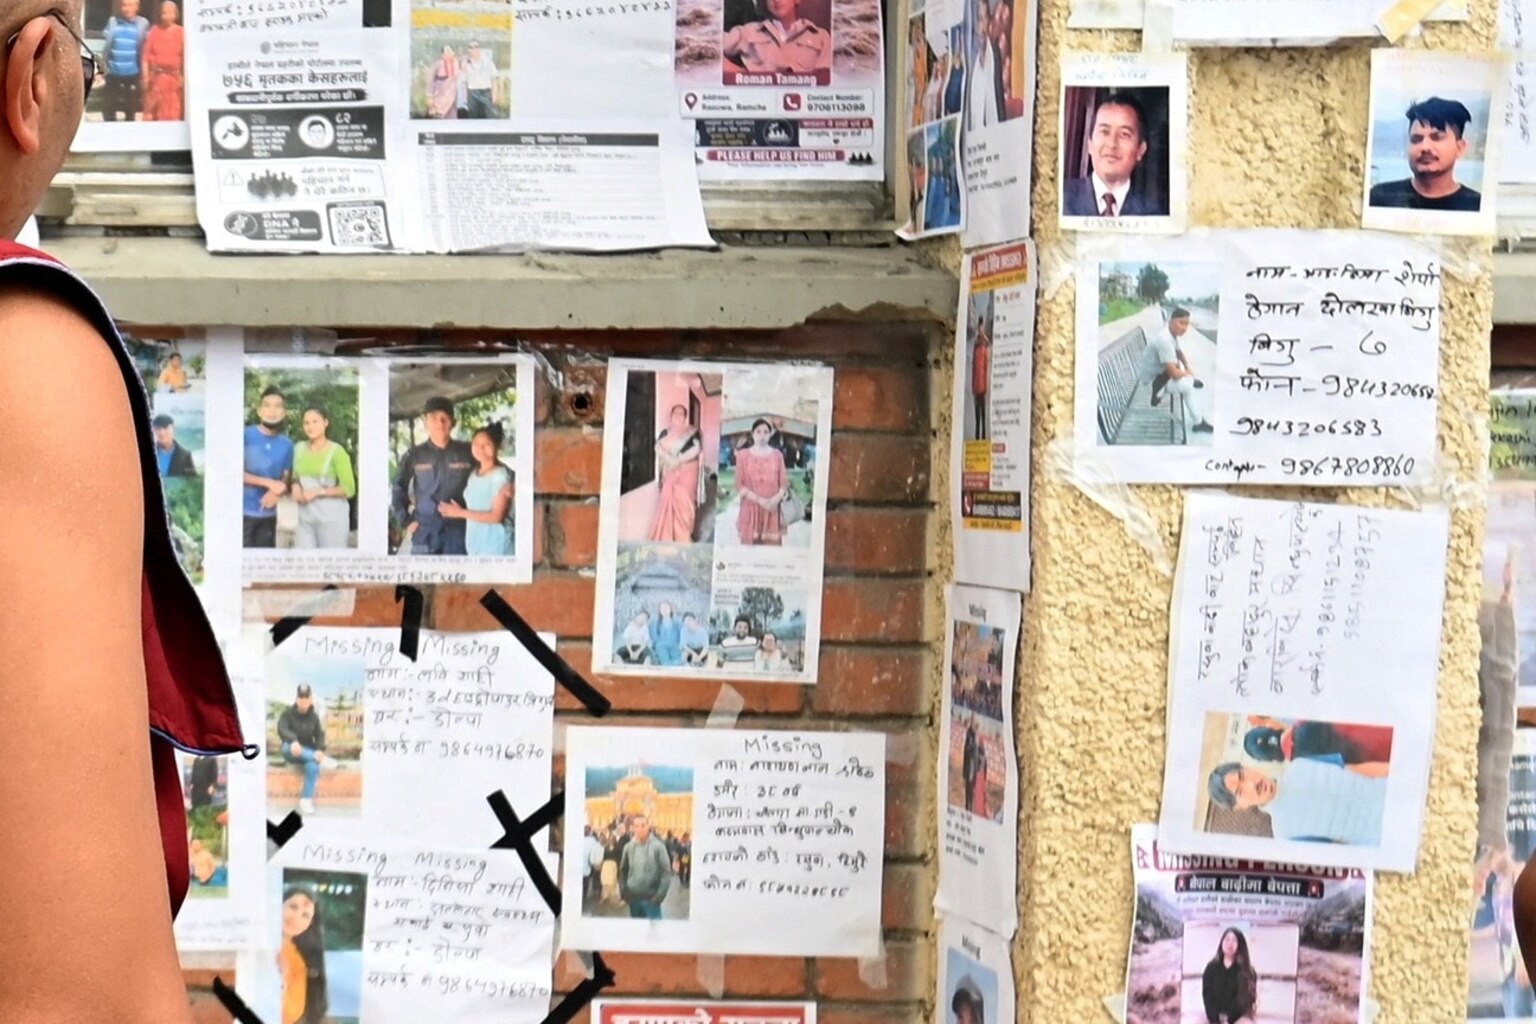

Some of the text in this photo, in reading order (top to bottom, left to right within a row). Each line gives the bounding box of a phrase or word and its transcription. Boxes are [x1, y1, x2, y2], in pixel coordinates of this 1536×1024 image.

[736, 74, 817, 86] Roman Tamang
[717, 150, 837, 161] PLEASE HELP US FIND HIM
[1281, 455, 1415, 476] 9867808860
[305, 634, 501, 666] Missing Missing
[744, 735, 823, 760] Missing
[302, 846, 487, 881] Missing Missing
